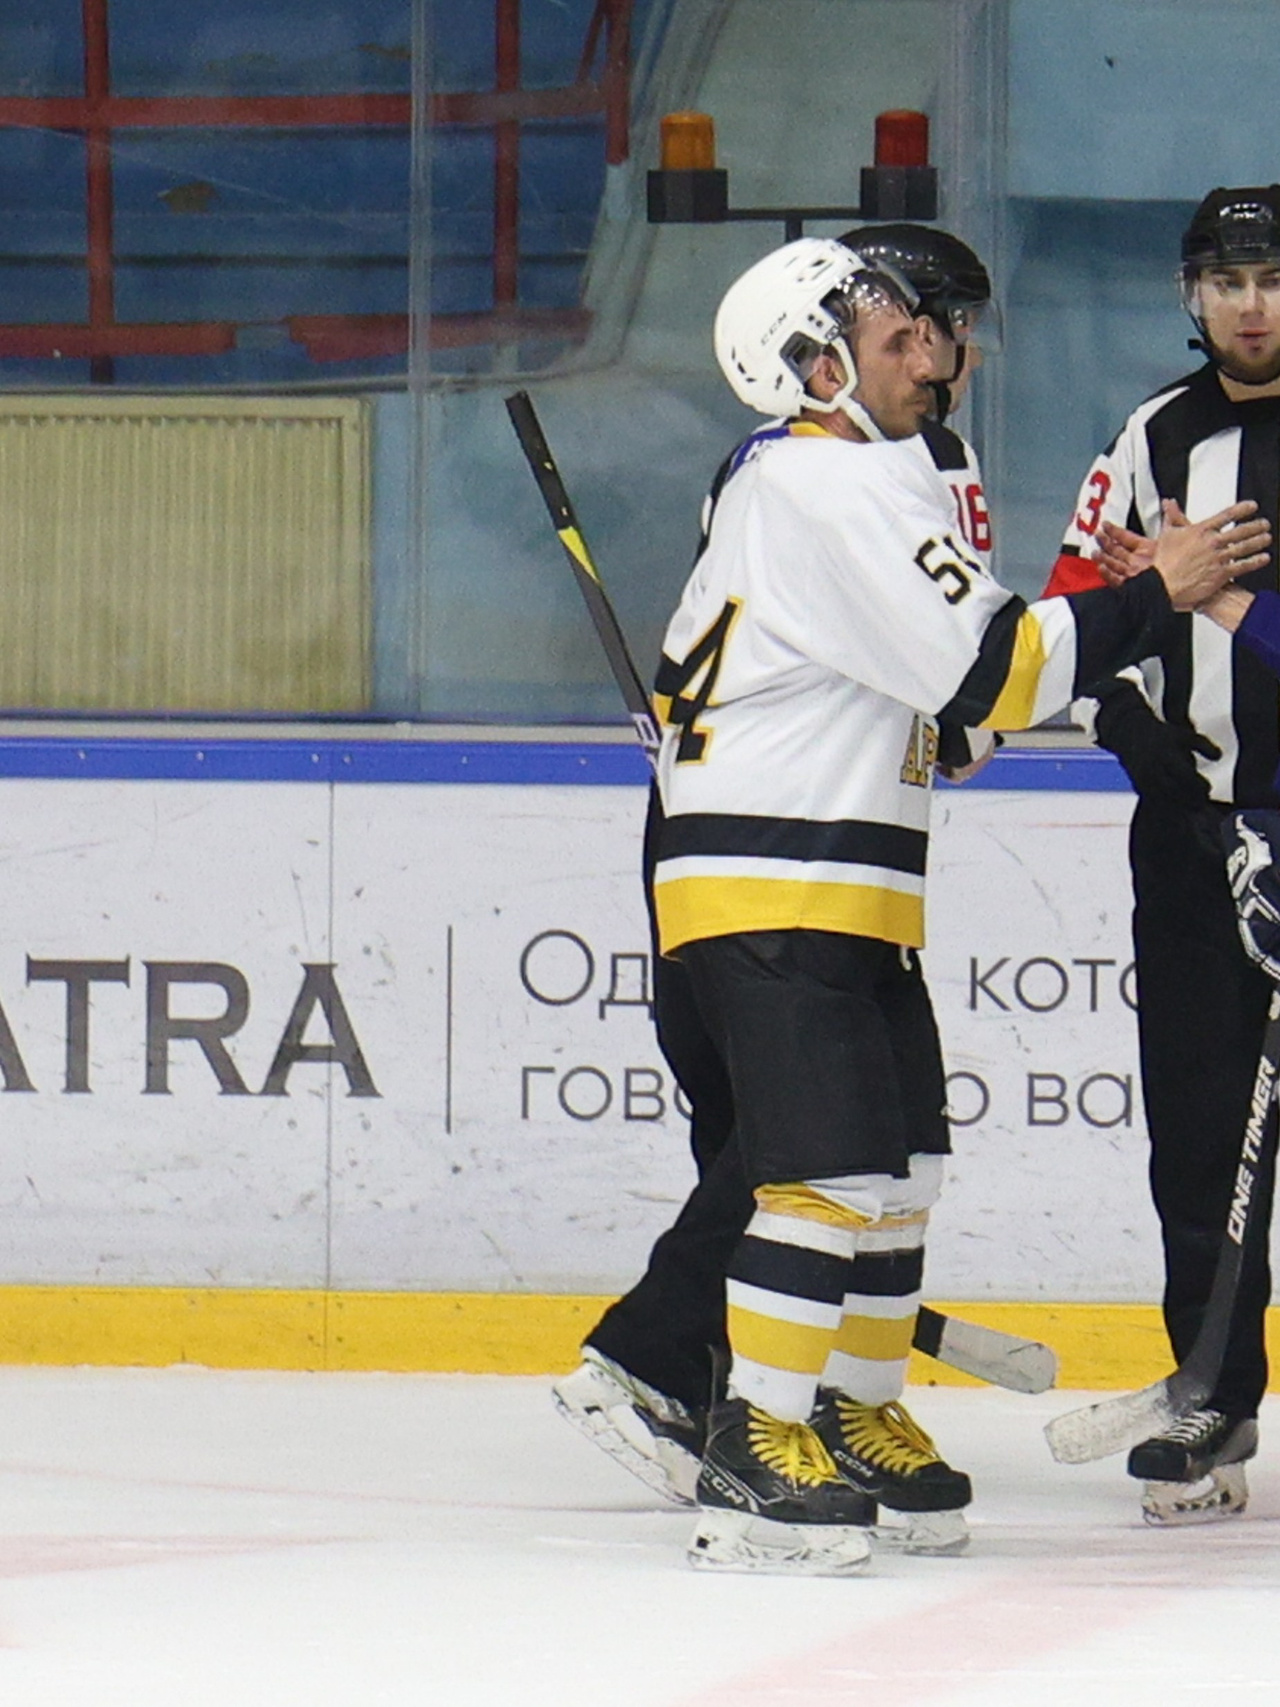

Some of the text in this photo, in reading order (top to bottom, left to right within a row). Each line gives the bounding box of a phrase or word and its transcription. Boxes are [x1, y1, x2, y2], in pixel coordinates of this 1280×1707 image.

[1071, 469, 1112, 537] 3
[913, 534, 989, 606] 5
[519, 928, 656, 1021] Од
[521, 1064, 692, 1123] гов
[1026, 1072, 1133, 1129] ва
[1227, 1055, 1277, 1246] ONE TIMER
[831, 1449, 875, 1479] CCM
